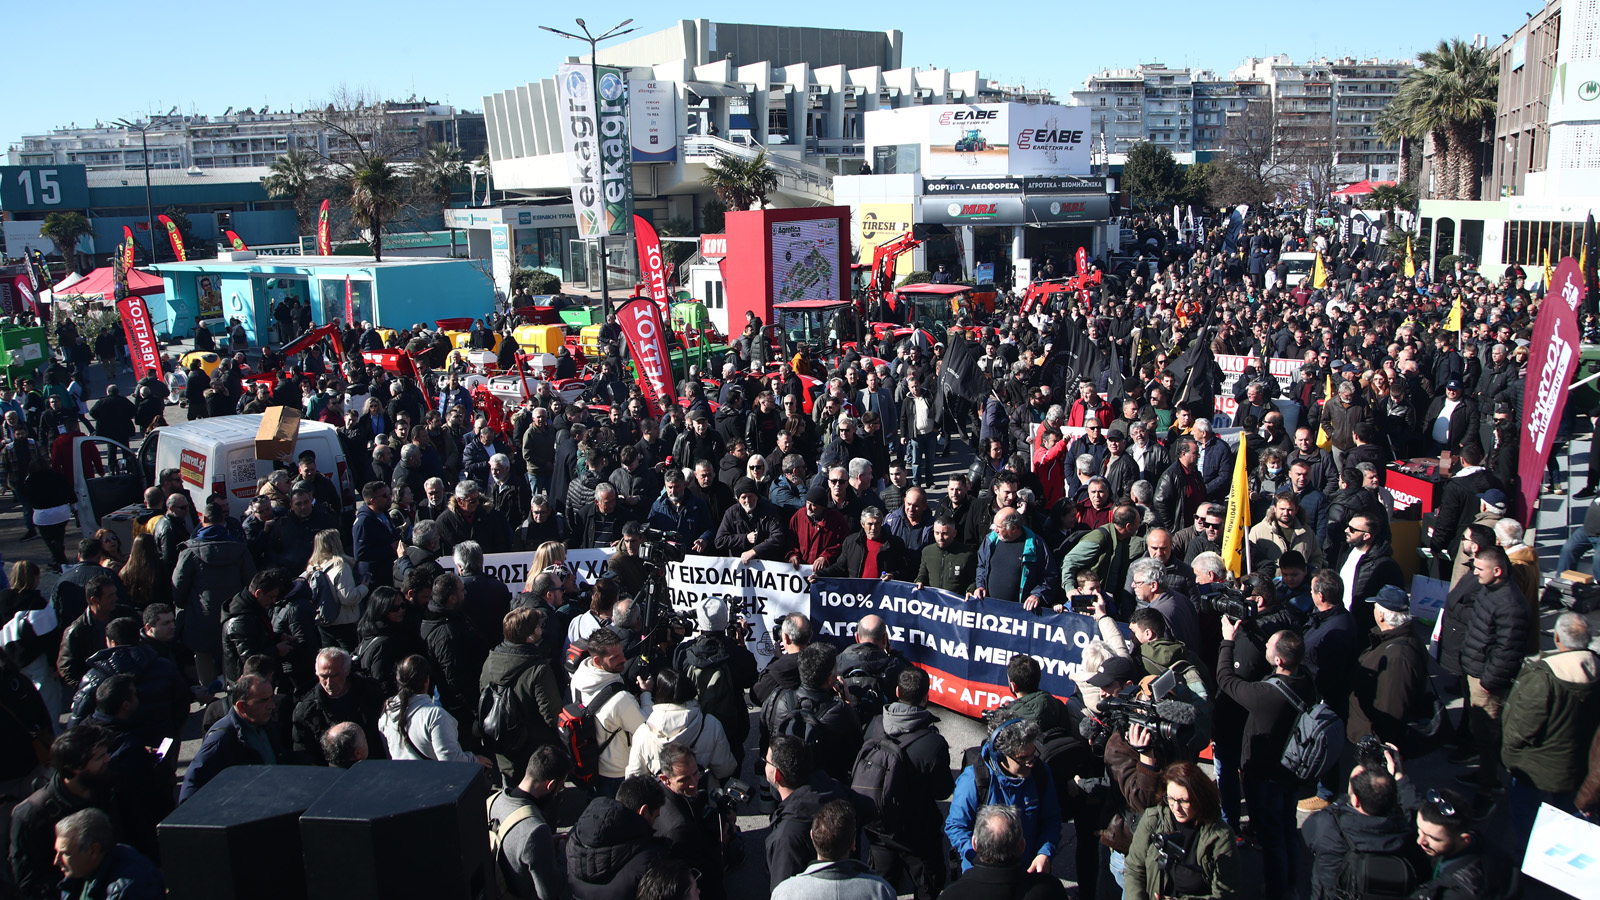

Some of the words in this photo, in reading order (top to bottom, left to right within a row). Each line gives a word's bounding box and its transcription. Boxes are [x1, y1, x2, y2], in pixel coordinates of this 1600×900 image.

[18, 169, 62, 205] 15
[928, 183, 964, 191] ΦΟΡΤΗΓΑ
[971, 182, 1020, 190] ΛΕΩΦΟΡΕΙΑ
[961, 203, 997, 214] MRL
[1060, 202, 1086, 212] MRL
[1527, 320, 1563, 443] HARDOX
[679, 566, 811, 594] ΕΙΣΟΔΗΜΑΤΟΣ
[819, 591, 874, 609] 100%
[879, 596, 1027, 637] ΑΠΟΖΗΜΕΙΩΣΗ
[1033, 623, 1067, 645] ΓΙΑ
[909, 629, 938, 651] ΓΙΑ
[940, 640, 969, 660] ΝΑ
